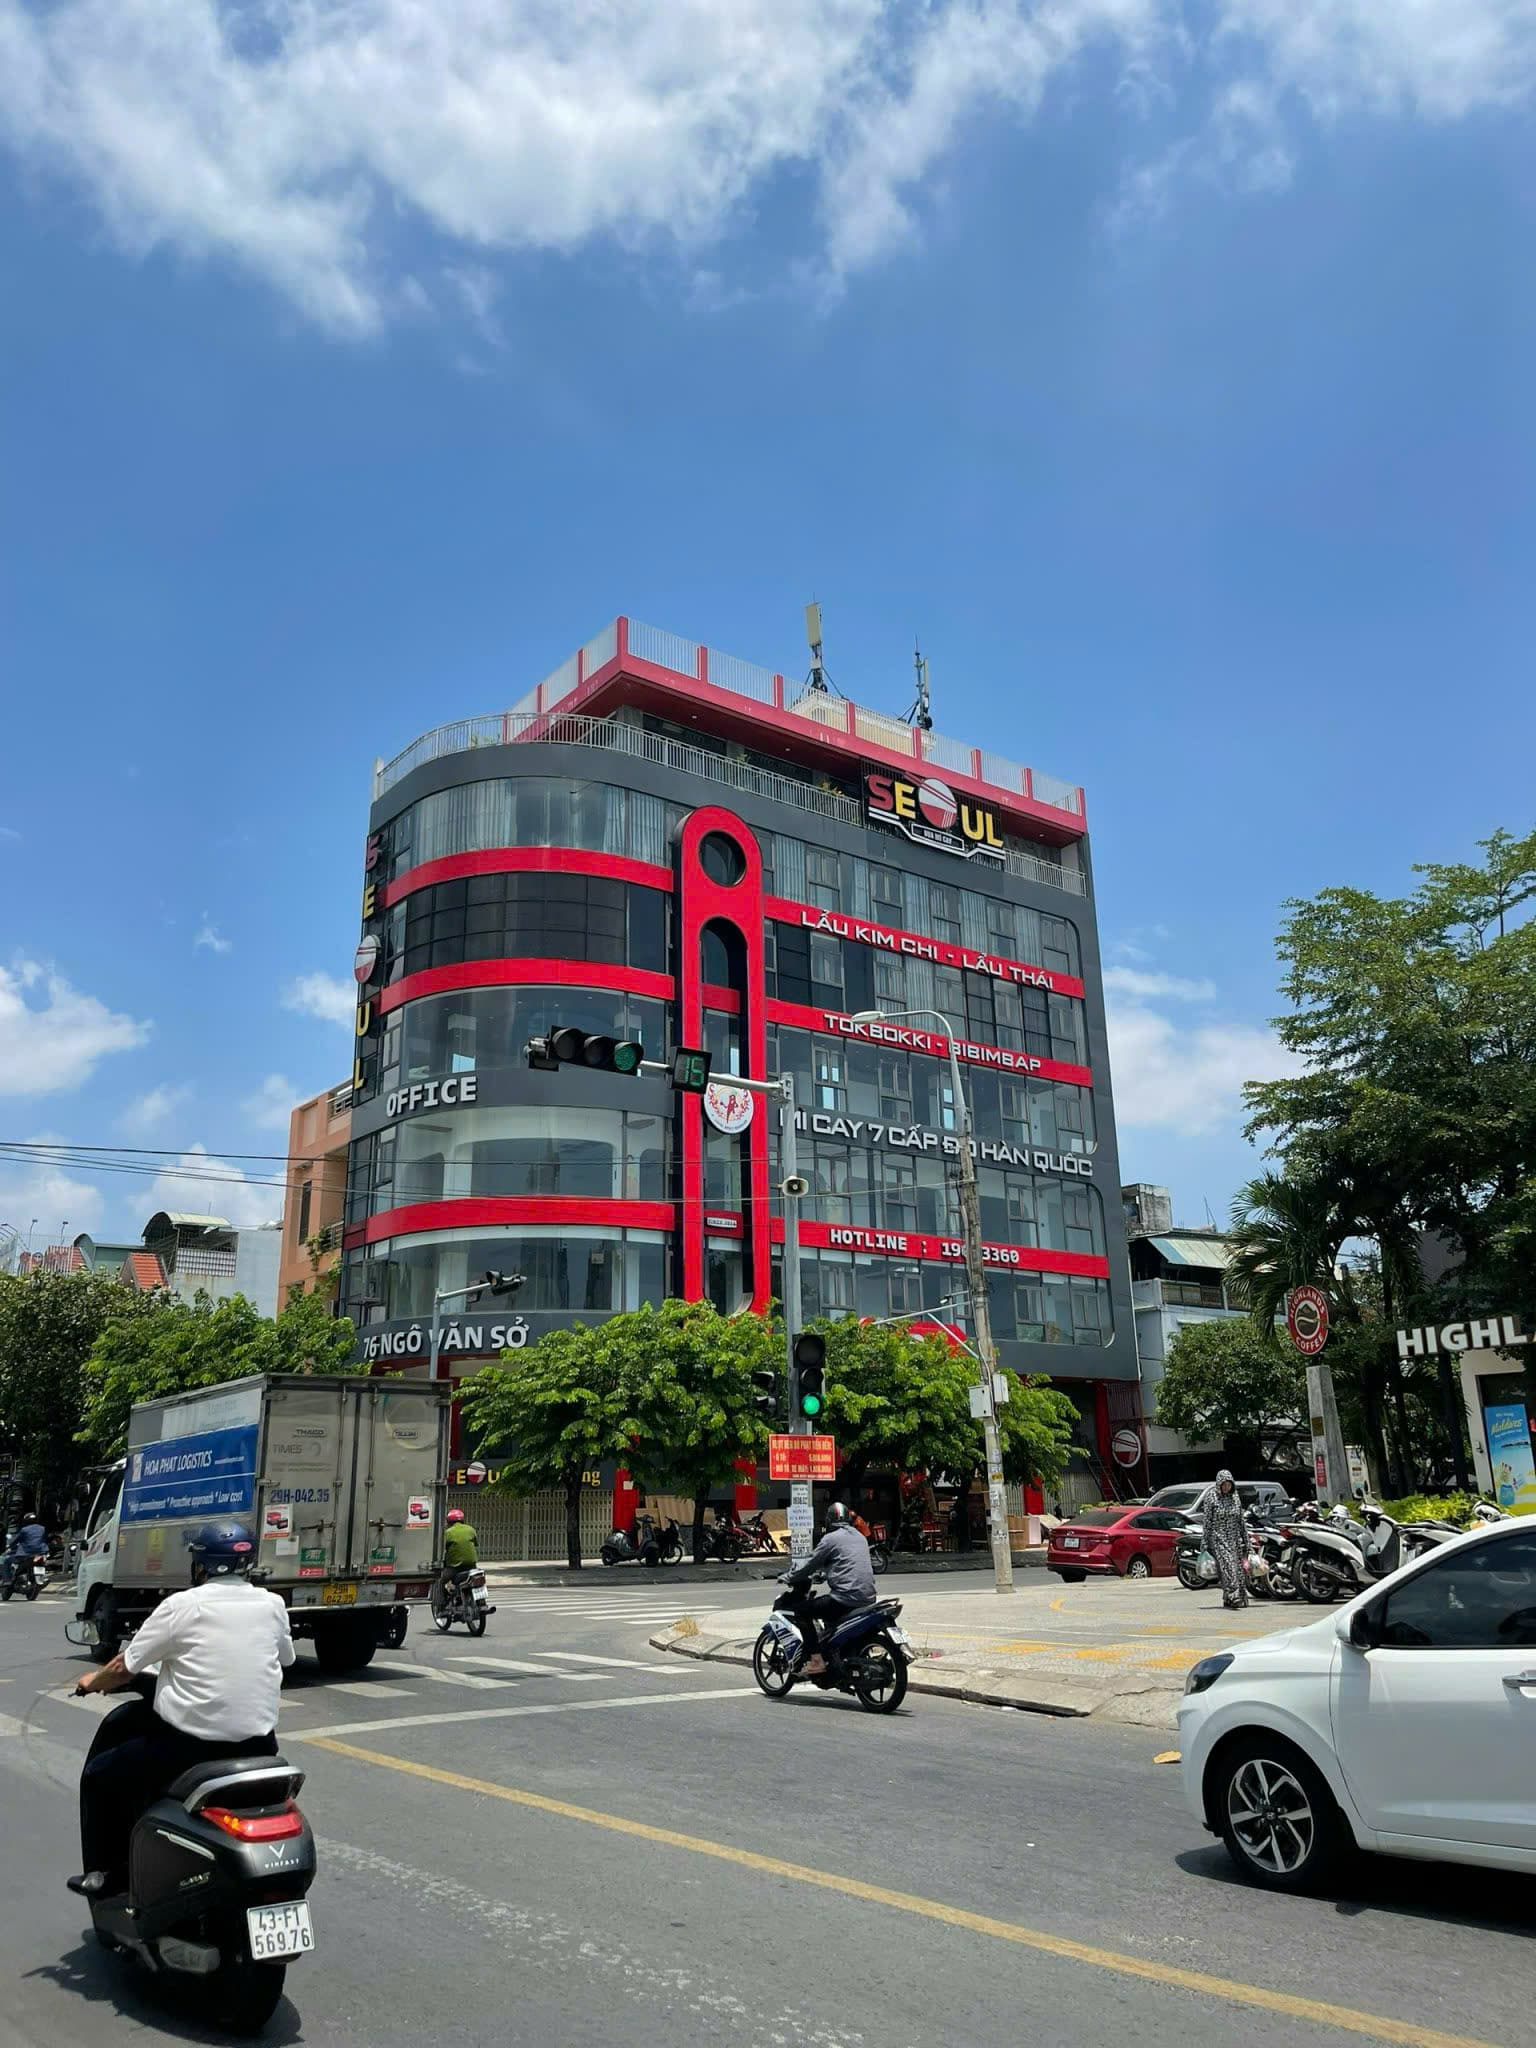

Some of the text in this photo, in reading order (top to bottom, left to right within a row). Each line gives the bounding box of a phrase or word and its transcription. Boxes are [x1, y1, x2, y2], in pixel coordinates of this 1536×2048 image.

[855, 925, 895, 948] KIM
[900, 937, 938, 960] CHI
[1008, 966, 1053, 990] THÁI
[823, 1013, 931, 1050] TOKBOKKI
[949, 1041, 1041, 1072] BIBIMBAP
[685, 1056, 705, 1087] 15
[386, 1075, 477, 1119] OFFICE
[812, 1113, 864, 1139] CAY
[868, 1123, 885, 1142] 7
[888, 1124, 938, 1151] CẤP
[981, 1140, 1030, 1166] HÀN
[829, 1227, 907, 1252] HOTLINE
[941, 1242, 1020, 1263] 193360
[428, 1321, 483, 1350] VĂN
[490, 1316, 529, 1349] SỞ
[1296, 1333, 1323, 1350] COFFEE
[1396, 1315, 1536, 1357] HIGHL
[143, 1460, 159, 1476] HOA
[160, 1455, 178, 1474] PHAT
[177, 1450, 213, 1472] LOGISTICS
[271, 1488, 330, 1503] 29H-042.35
[264, 1858, 300, 1869] VINFAST
[259, 1906, 300, 1931] 43-F1
[255, 1928, 310, 1955] 569.76
